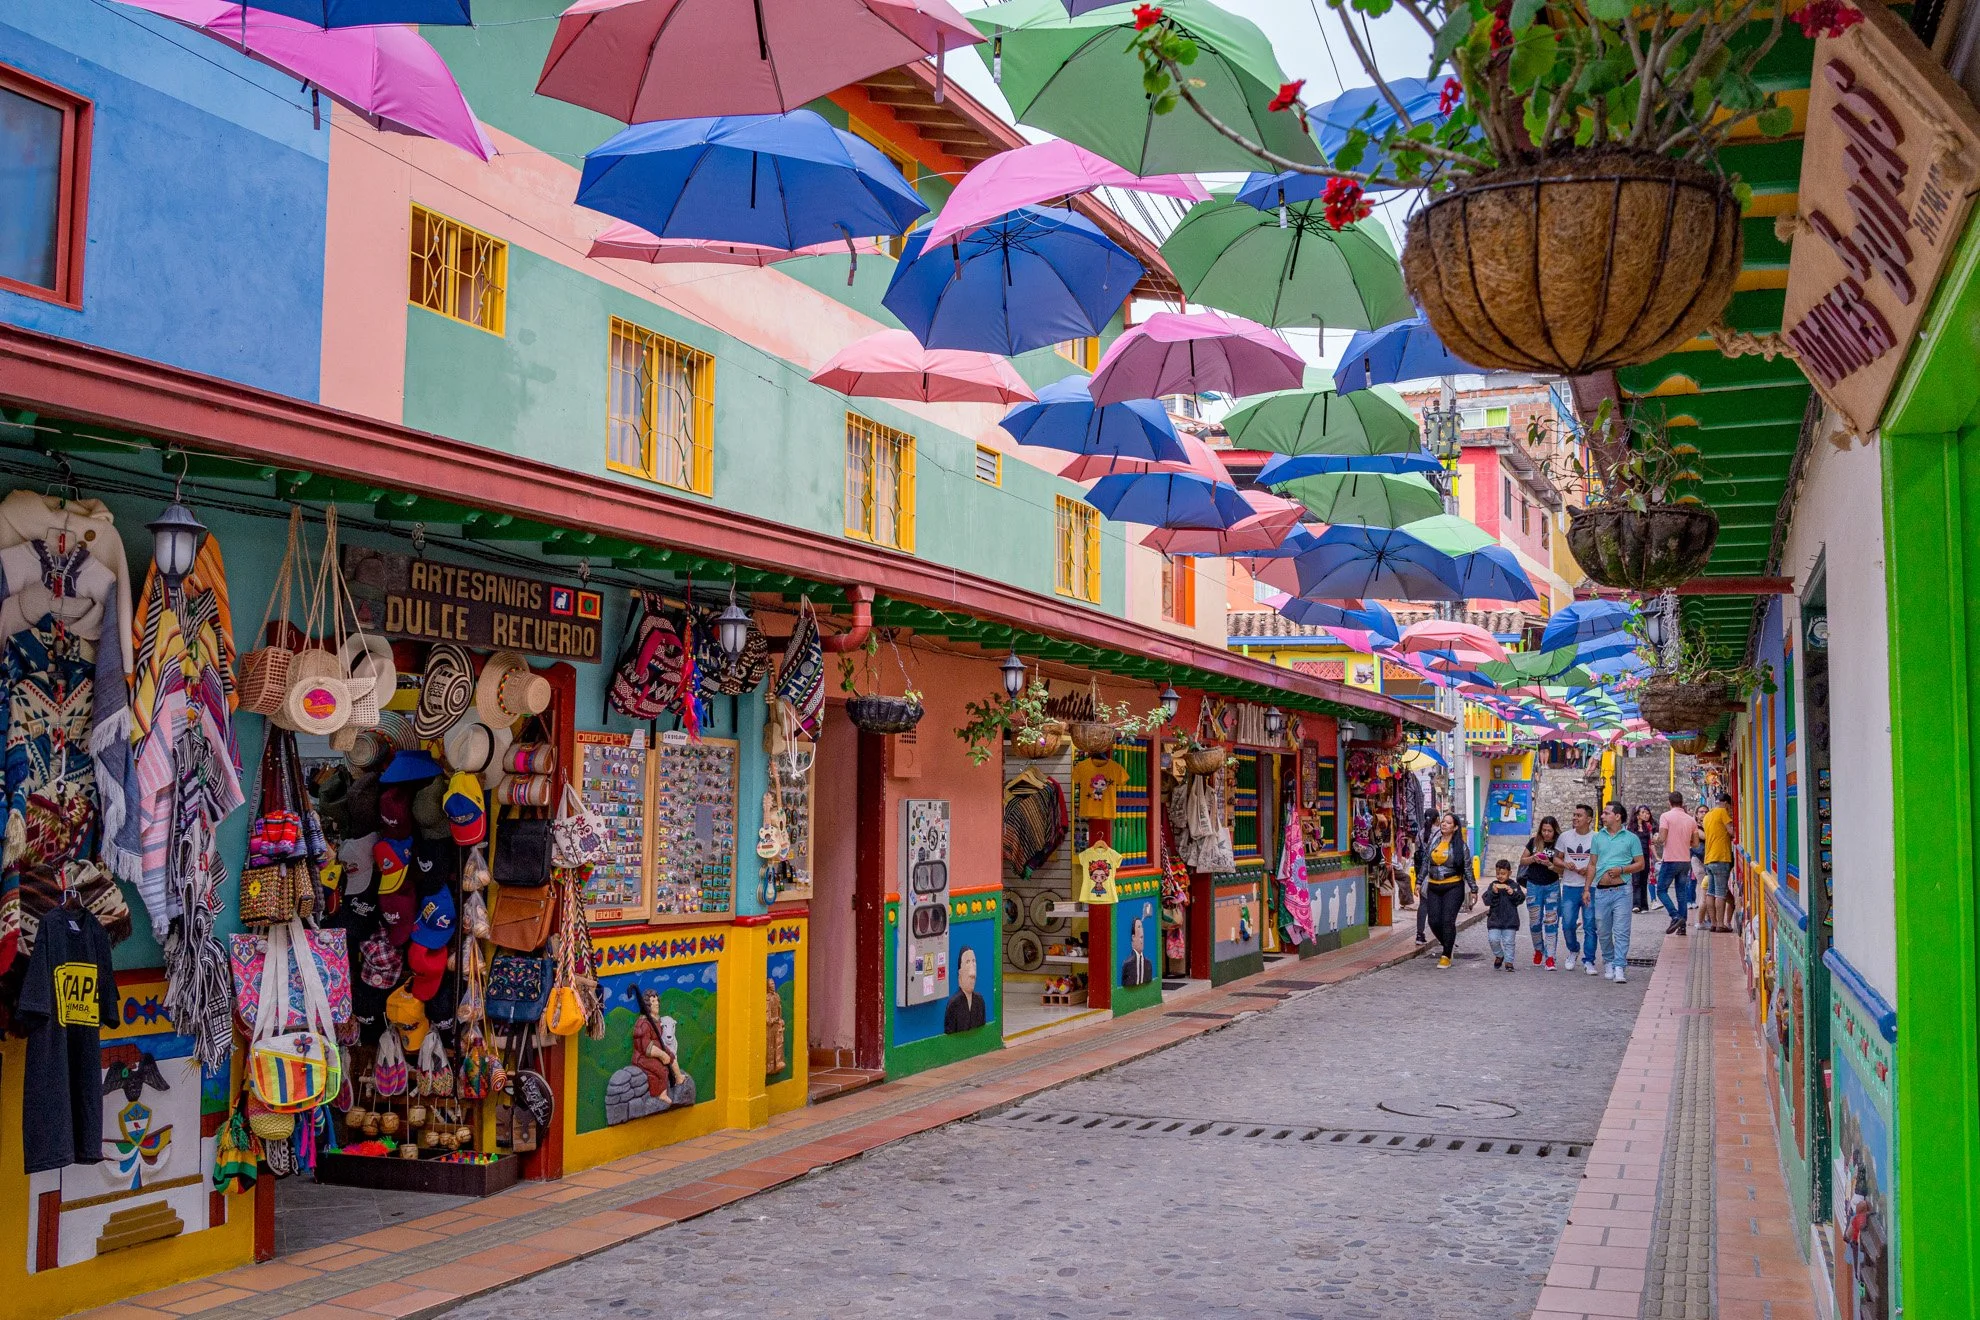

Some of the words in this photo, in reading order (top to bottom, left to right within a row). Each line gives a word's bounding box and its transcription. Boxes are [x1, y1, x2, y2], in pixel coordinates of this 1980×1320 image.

[1823, 57, 1917, 306] BOTAS
[1787, 276, 1898, 389] BOTINES
[386, 595, 470, 642] DULCE
[493, 611, 595, 657] RECUERDO
[411, 561, 543, 610] ARTESANIAS
